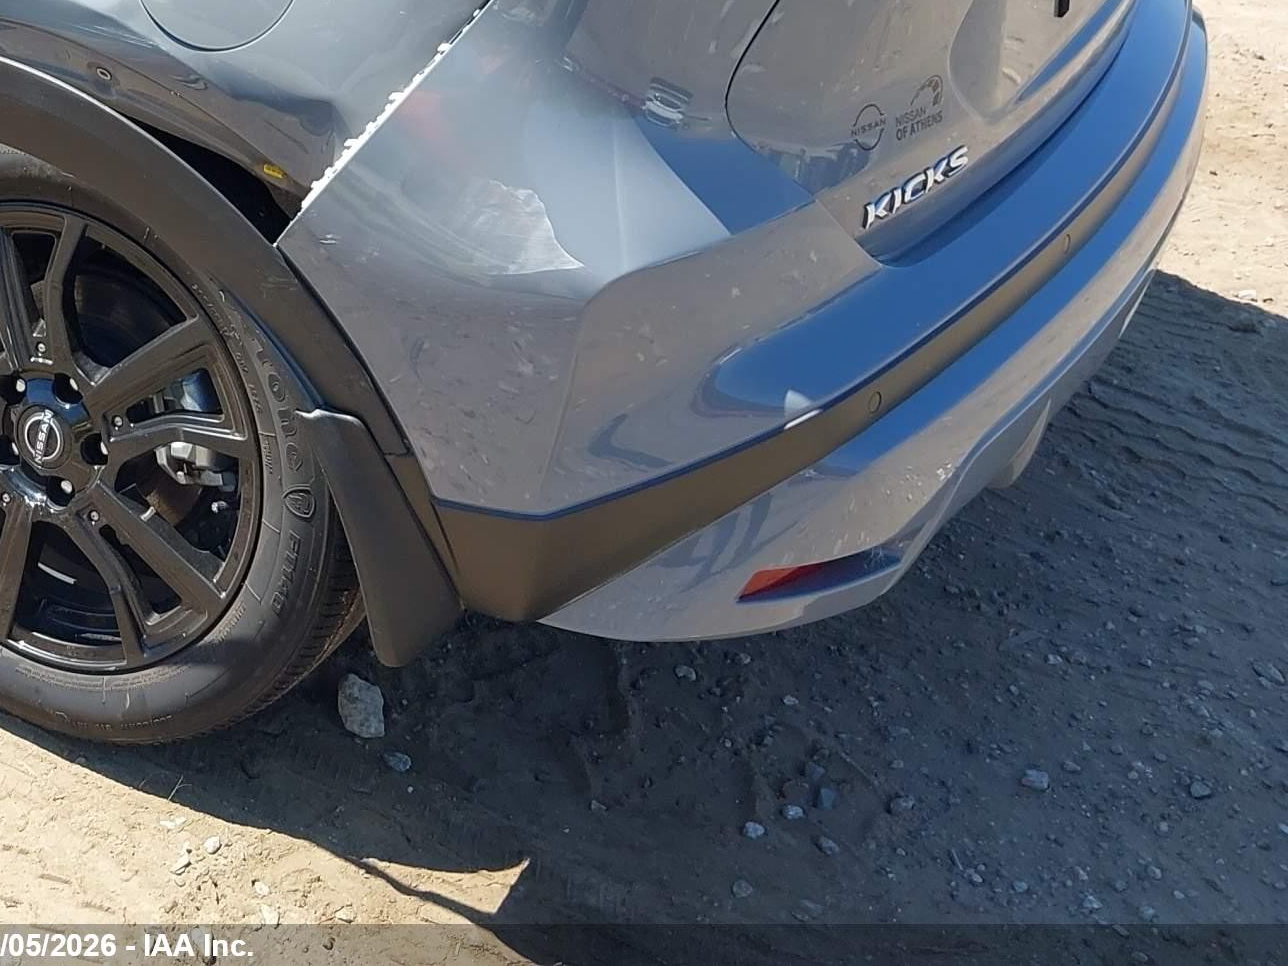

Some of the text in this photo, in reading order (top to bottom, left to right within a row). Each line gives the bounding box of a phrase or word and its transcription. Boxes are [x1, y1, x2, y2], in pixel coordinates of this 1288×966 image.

[850, 117, 887, 138] NISSAN
[896, 106, 926, 127] NISSAN
[896, 109, 943, 141] OF ATHENS
[862, 144, 969, 230] KICKS
[34, 409, 54, 464] NISSAN
